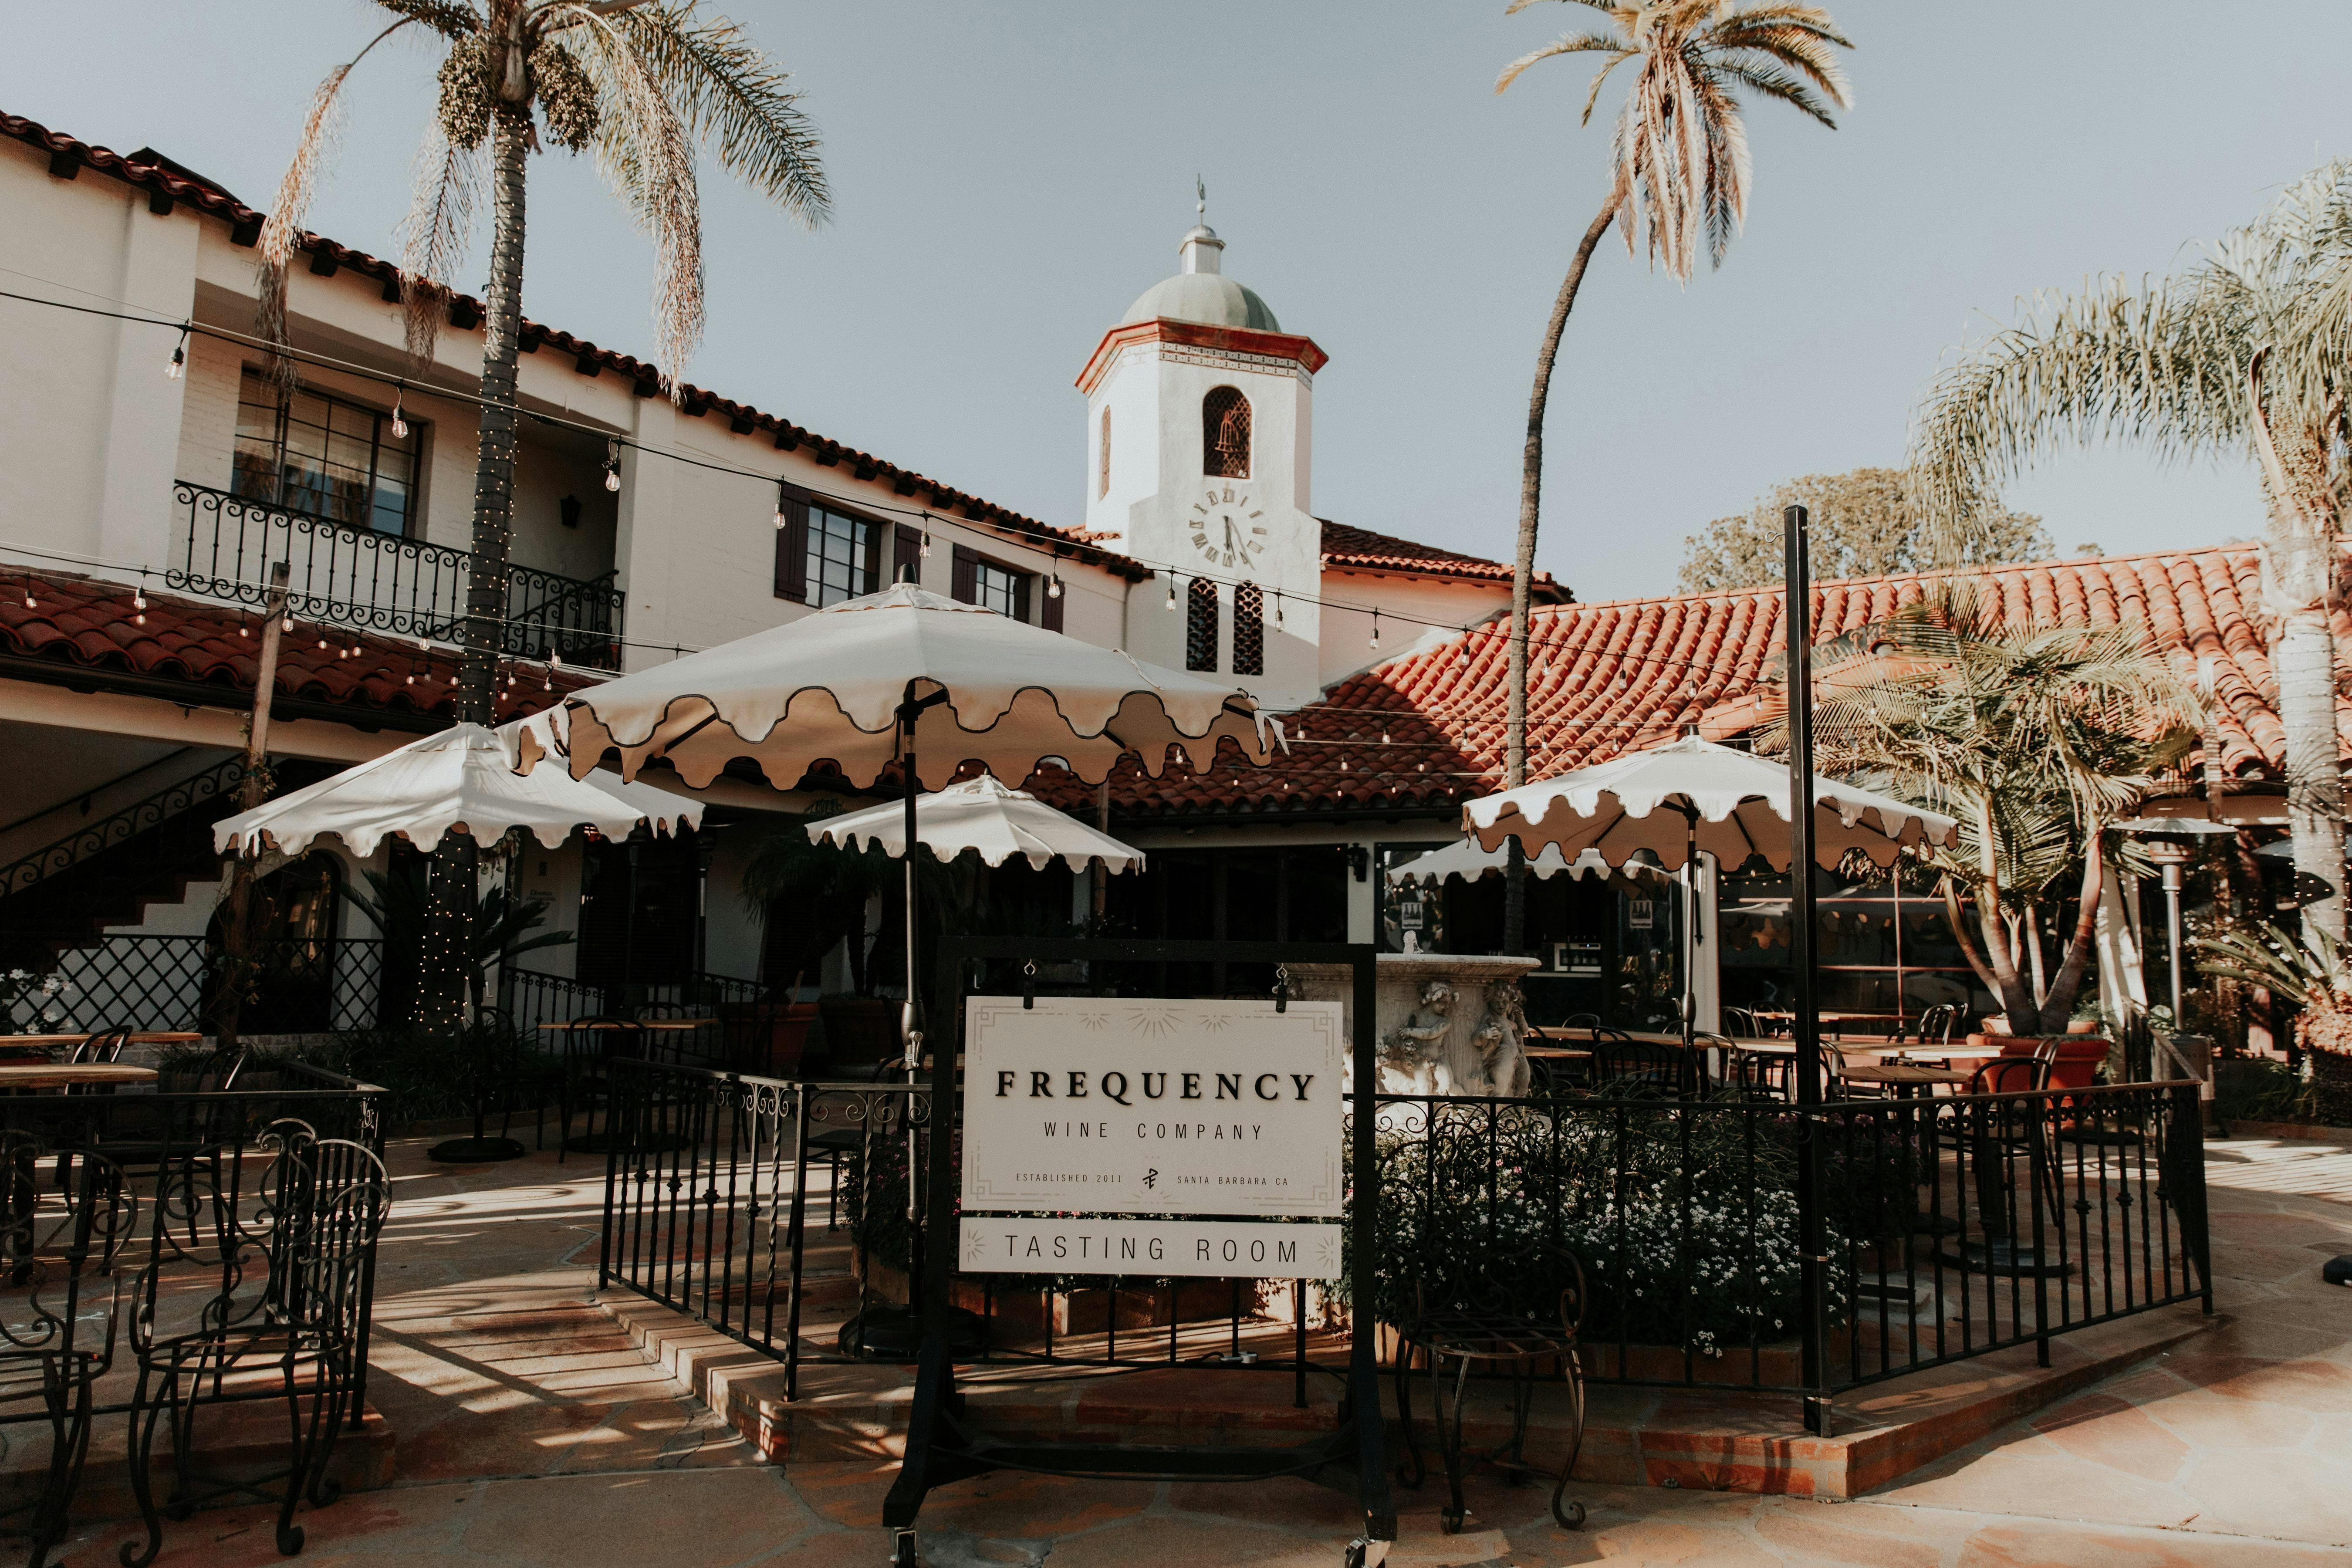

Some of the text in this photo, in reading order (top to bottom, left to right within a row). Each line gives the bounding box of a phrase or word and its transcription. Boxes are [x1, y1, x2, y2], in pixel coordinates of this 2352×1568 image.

[995, 1070, 1315, 1106] FREQUENCY
[1044, 1122, 1261, 1140] WINE COMPANY
[1016, 1173, 1288, 1186] ESTABLISHED 2011 SANTA BARBARA CA
[1005, 1235, 1296, 1263] TASTING ROOM
